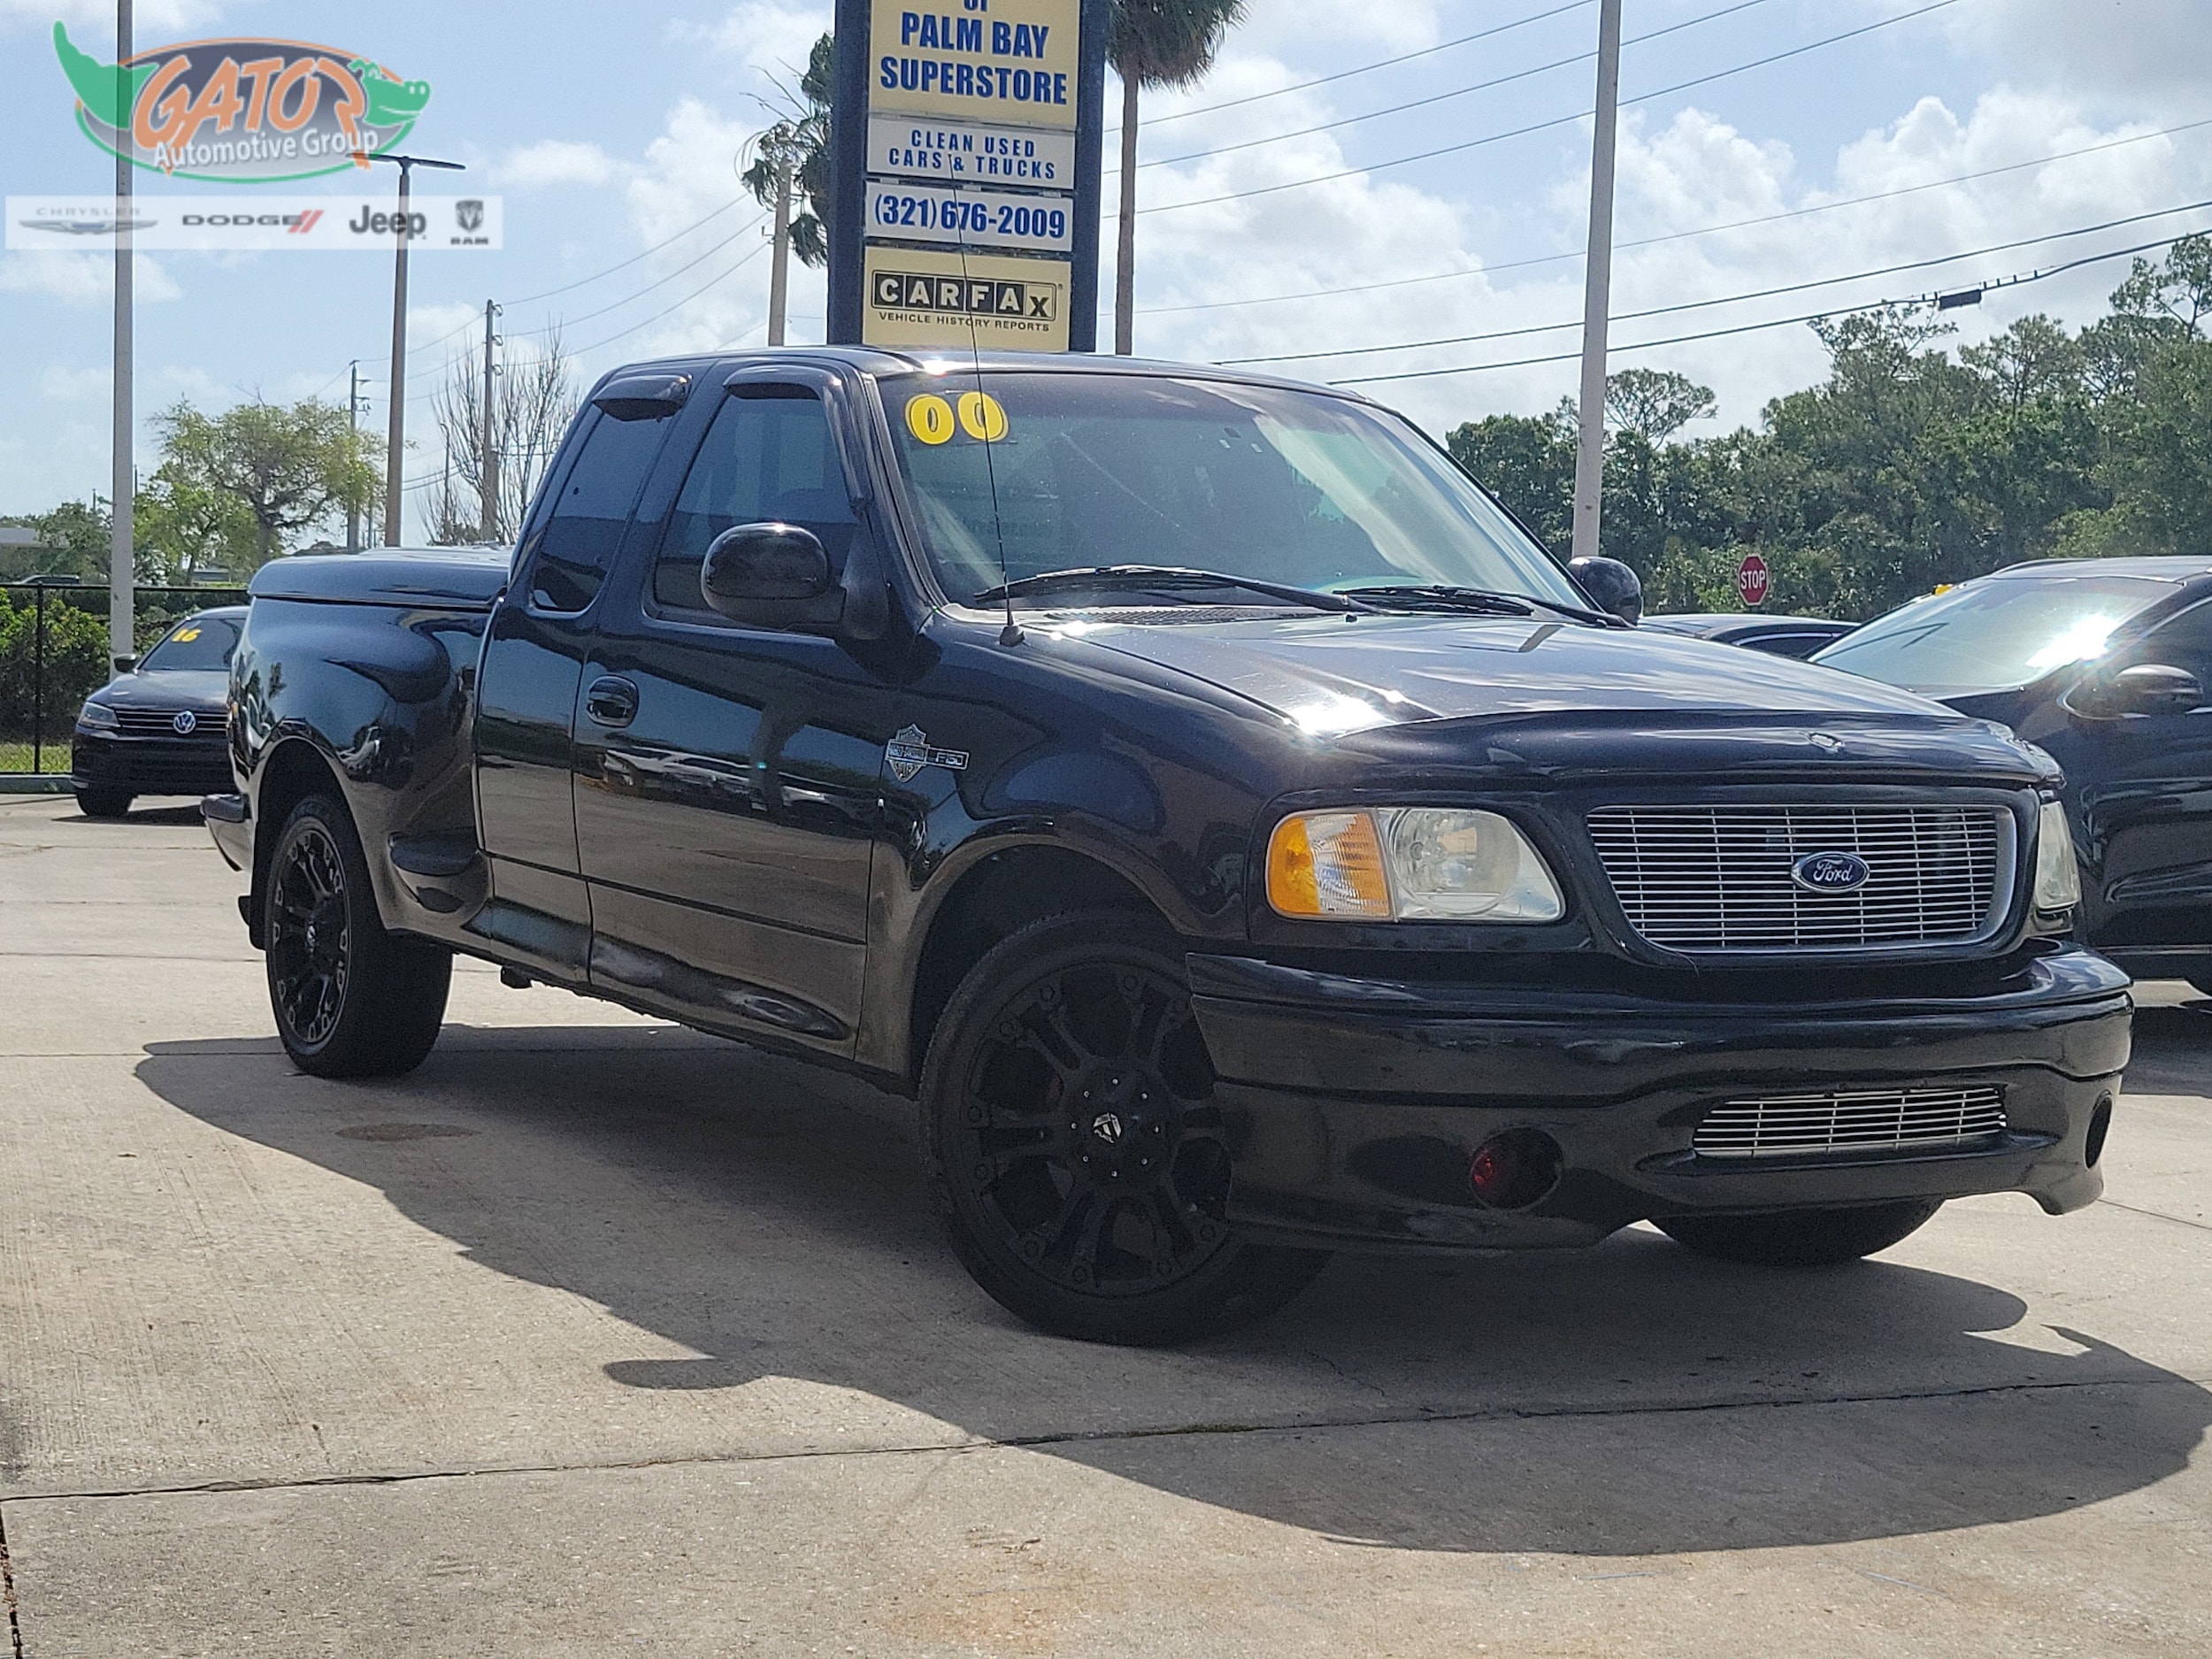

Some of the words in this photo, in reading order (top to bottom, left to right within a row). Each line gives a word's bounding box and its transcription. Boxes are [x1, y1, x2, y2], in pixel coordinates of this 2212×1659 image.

[901, 12, 982, 53] PALM
[992, 21, 1050, 58] BAY
[880, 56, 1068, 105] SUPERSTORE
[911, 130, 973, 152] CLEAN
[984, 136, 1035, 157] USED
[888, 148, 942, 169] CARS
[953, 156, 964, 172] &
[975, 156, 1056, 179] TRUCKS
[874, 193, 1065, 239] (321)676-2009
[879, 278, 1050, 319] CARFAX
[879, 311, 931, 324] VEHICLE
[937, 316, 991, 328] HISTORY
[995, 320, 1049, 332] REPORTS
[905, 392, 1009, 445] 00
[1740, 570, 1765, 590] STOP
[172, 628, 202, 642] 16
[1812, 858, 1854, 881] Ford
